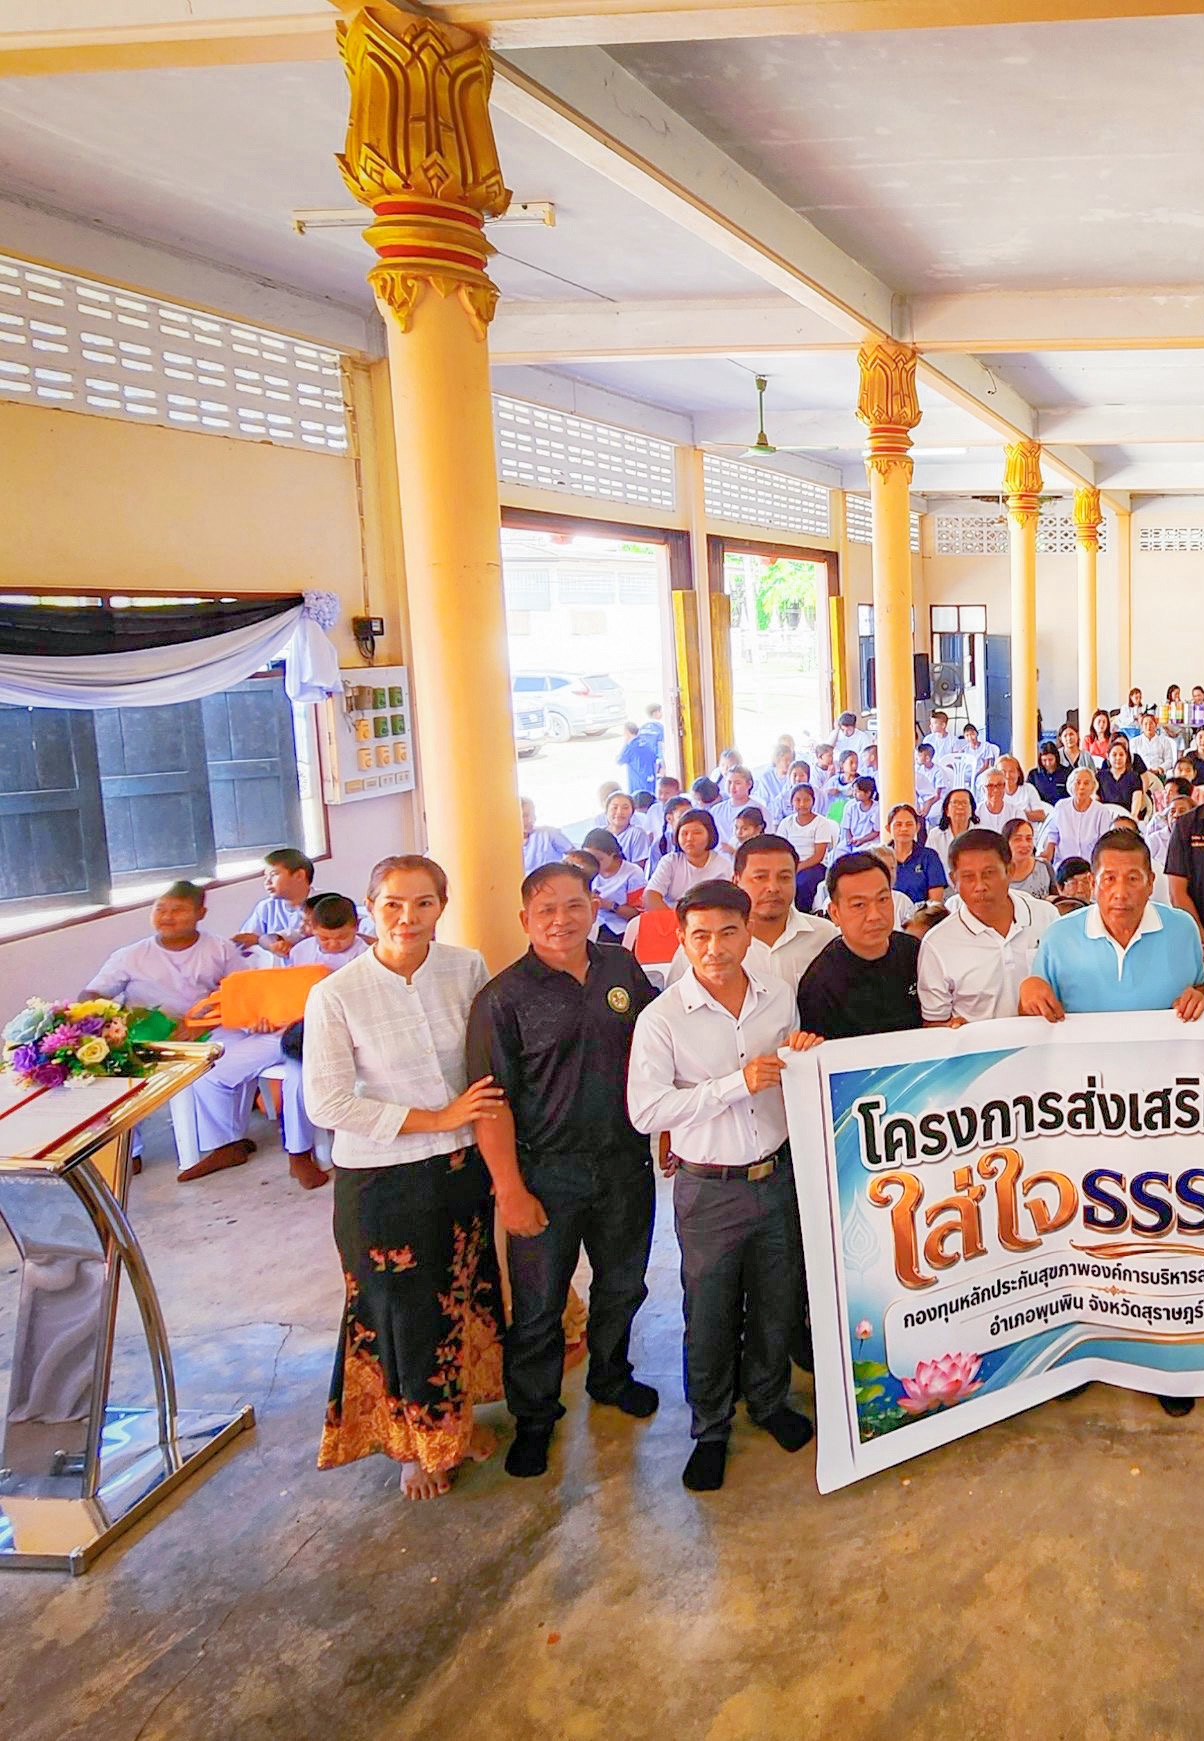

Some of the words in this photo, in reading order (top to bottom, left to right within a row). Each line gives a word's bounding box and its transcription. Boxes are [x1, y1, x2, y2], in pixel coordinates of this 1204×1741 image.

[989, 1293, 1084, 1336] อำเภอพุนพิน
